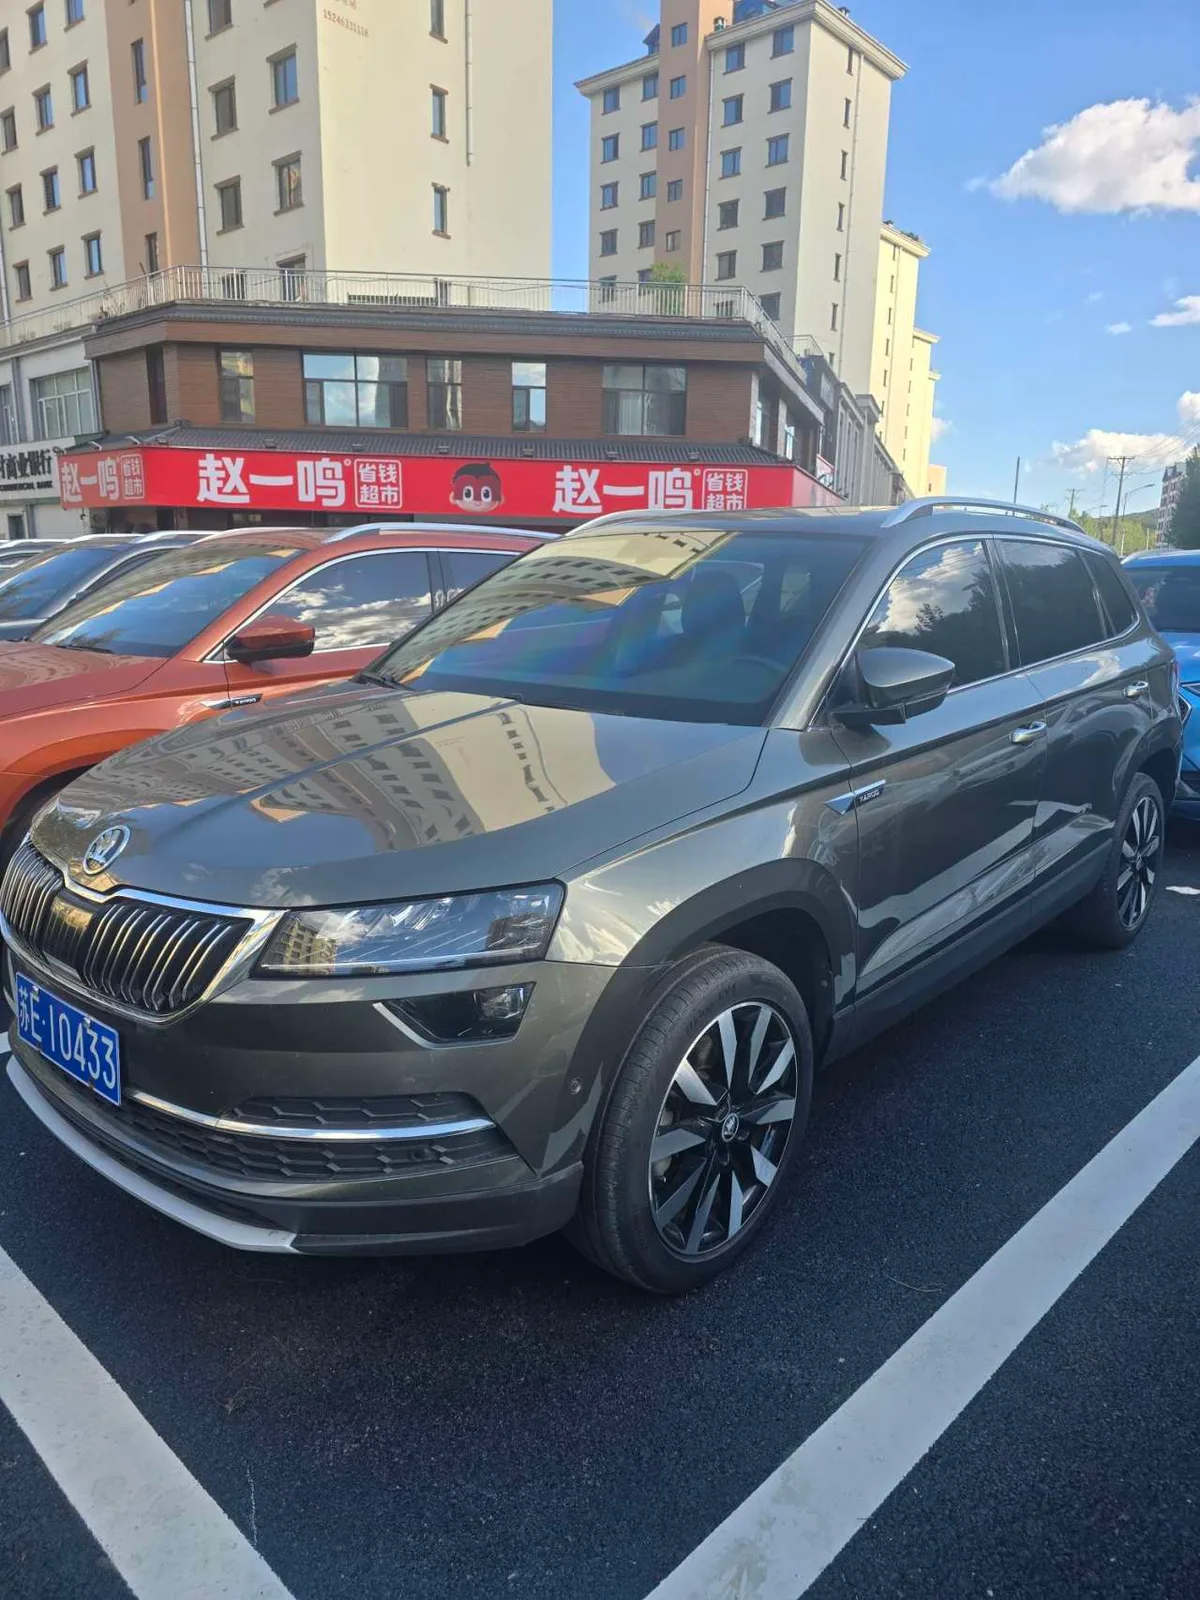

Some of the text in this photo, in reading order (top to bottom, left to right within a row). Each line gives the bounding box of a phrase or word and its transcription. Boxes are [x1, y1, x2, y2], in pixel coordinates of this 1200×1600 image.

[61, 457, 119, 502] 赵一鸣
[197, 453, 346, 507] 赵一鸣
[359, 463, 398, 483] 省钱
[552, 465, 693, 513] 赵一鸣
[706, 472, 744, 492] 省钱
[359, 485, 399, 504] 超市
